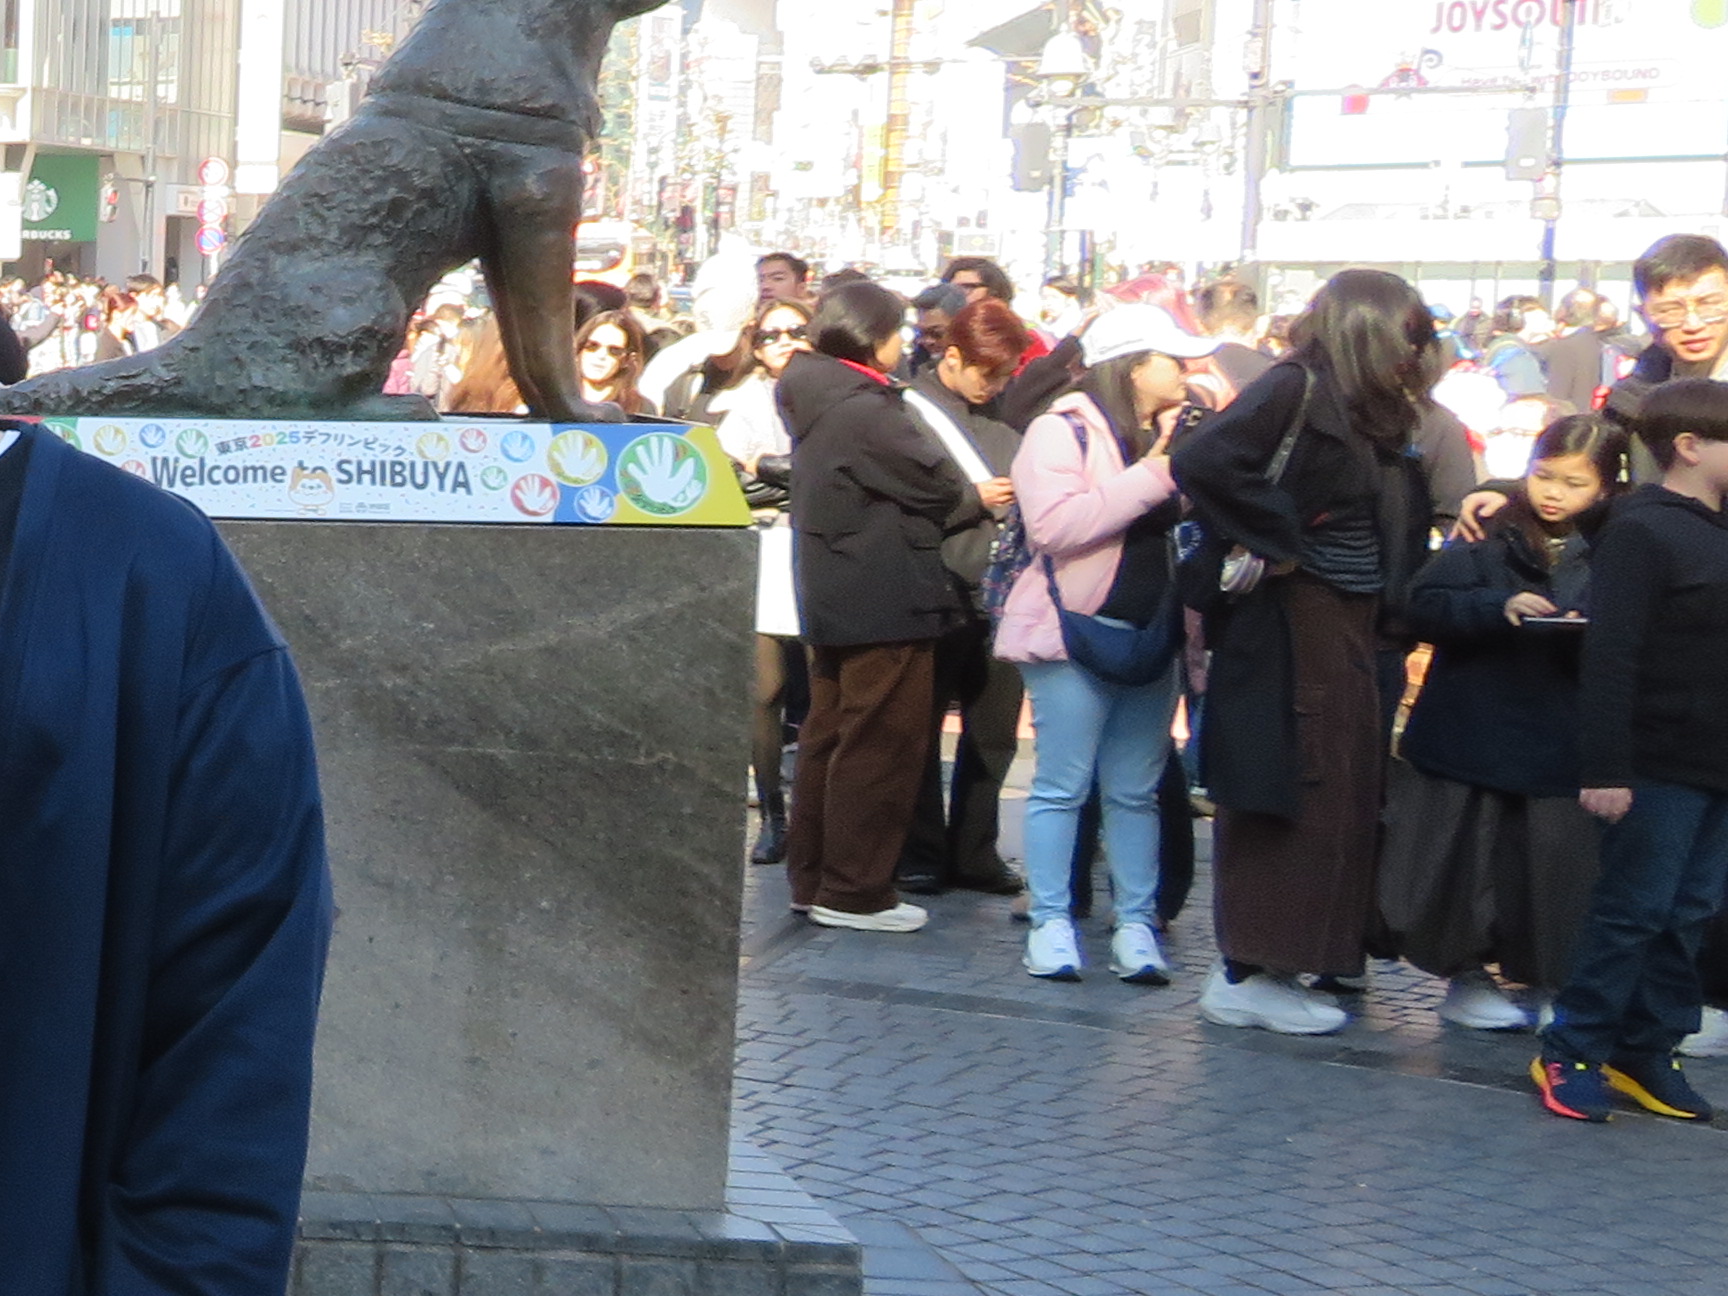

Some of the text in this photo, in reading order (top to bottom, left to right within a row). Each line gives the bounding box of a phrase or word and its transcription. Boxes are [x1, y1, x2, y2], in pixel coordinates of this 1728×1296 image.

[214, 430, 408, 458] 東京2025デフリンピック
[150, 456, 287, 491] Welcome
[334, 458, 473, 497] SHIBUYA
